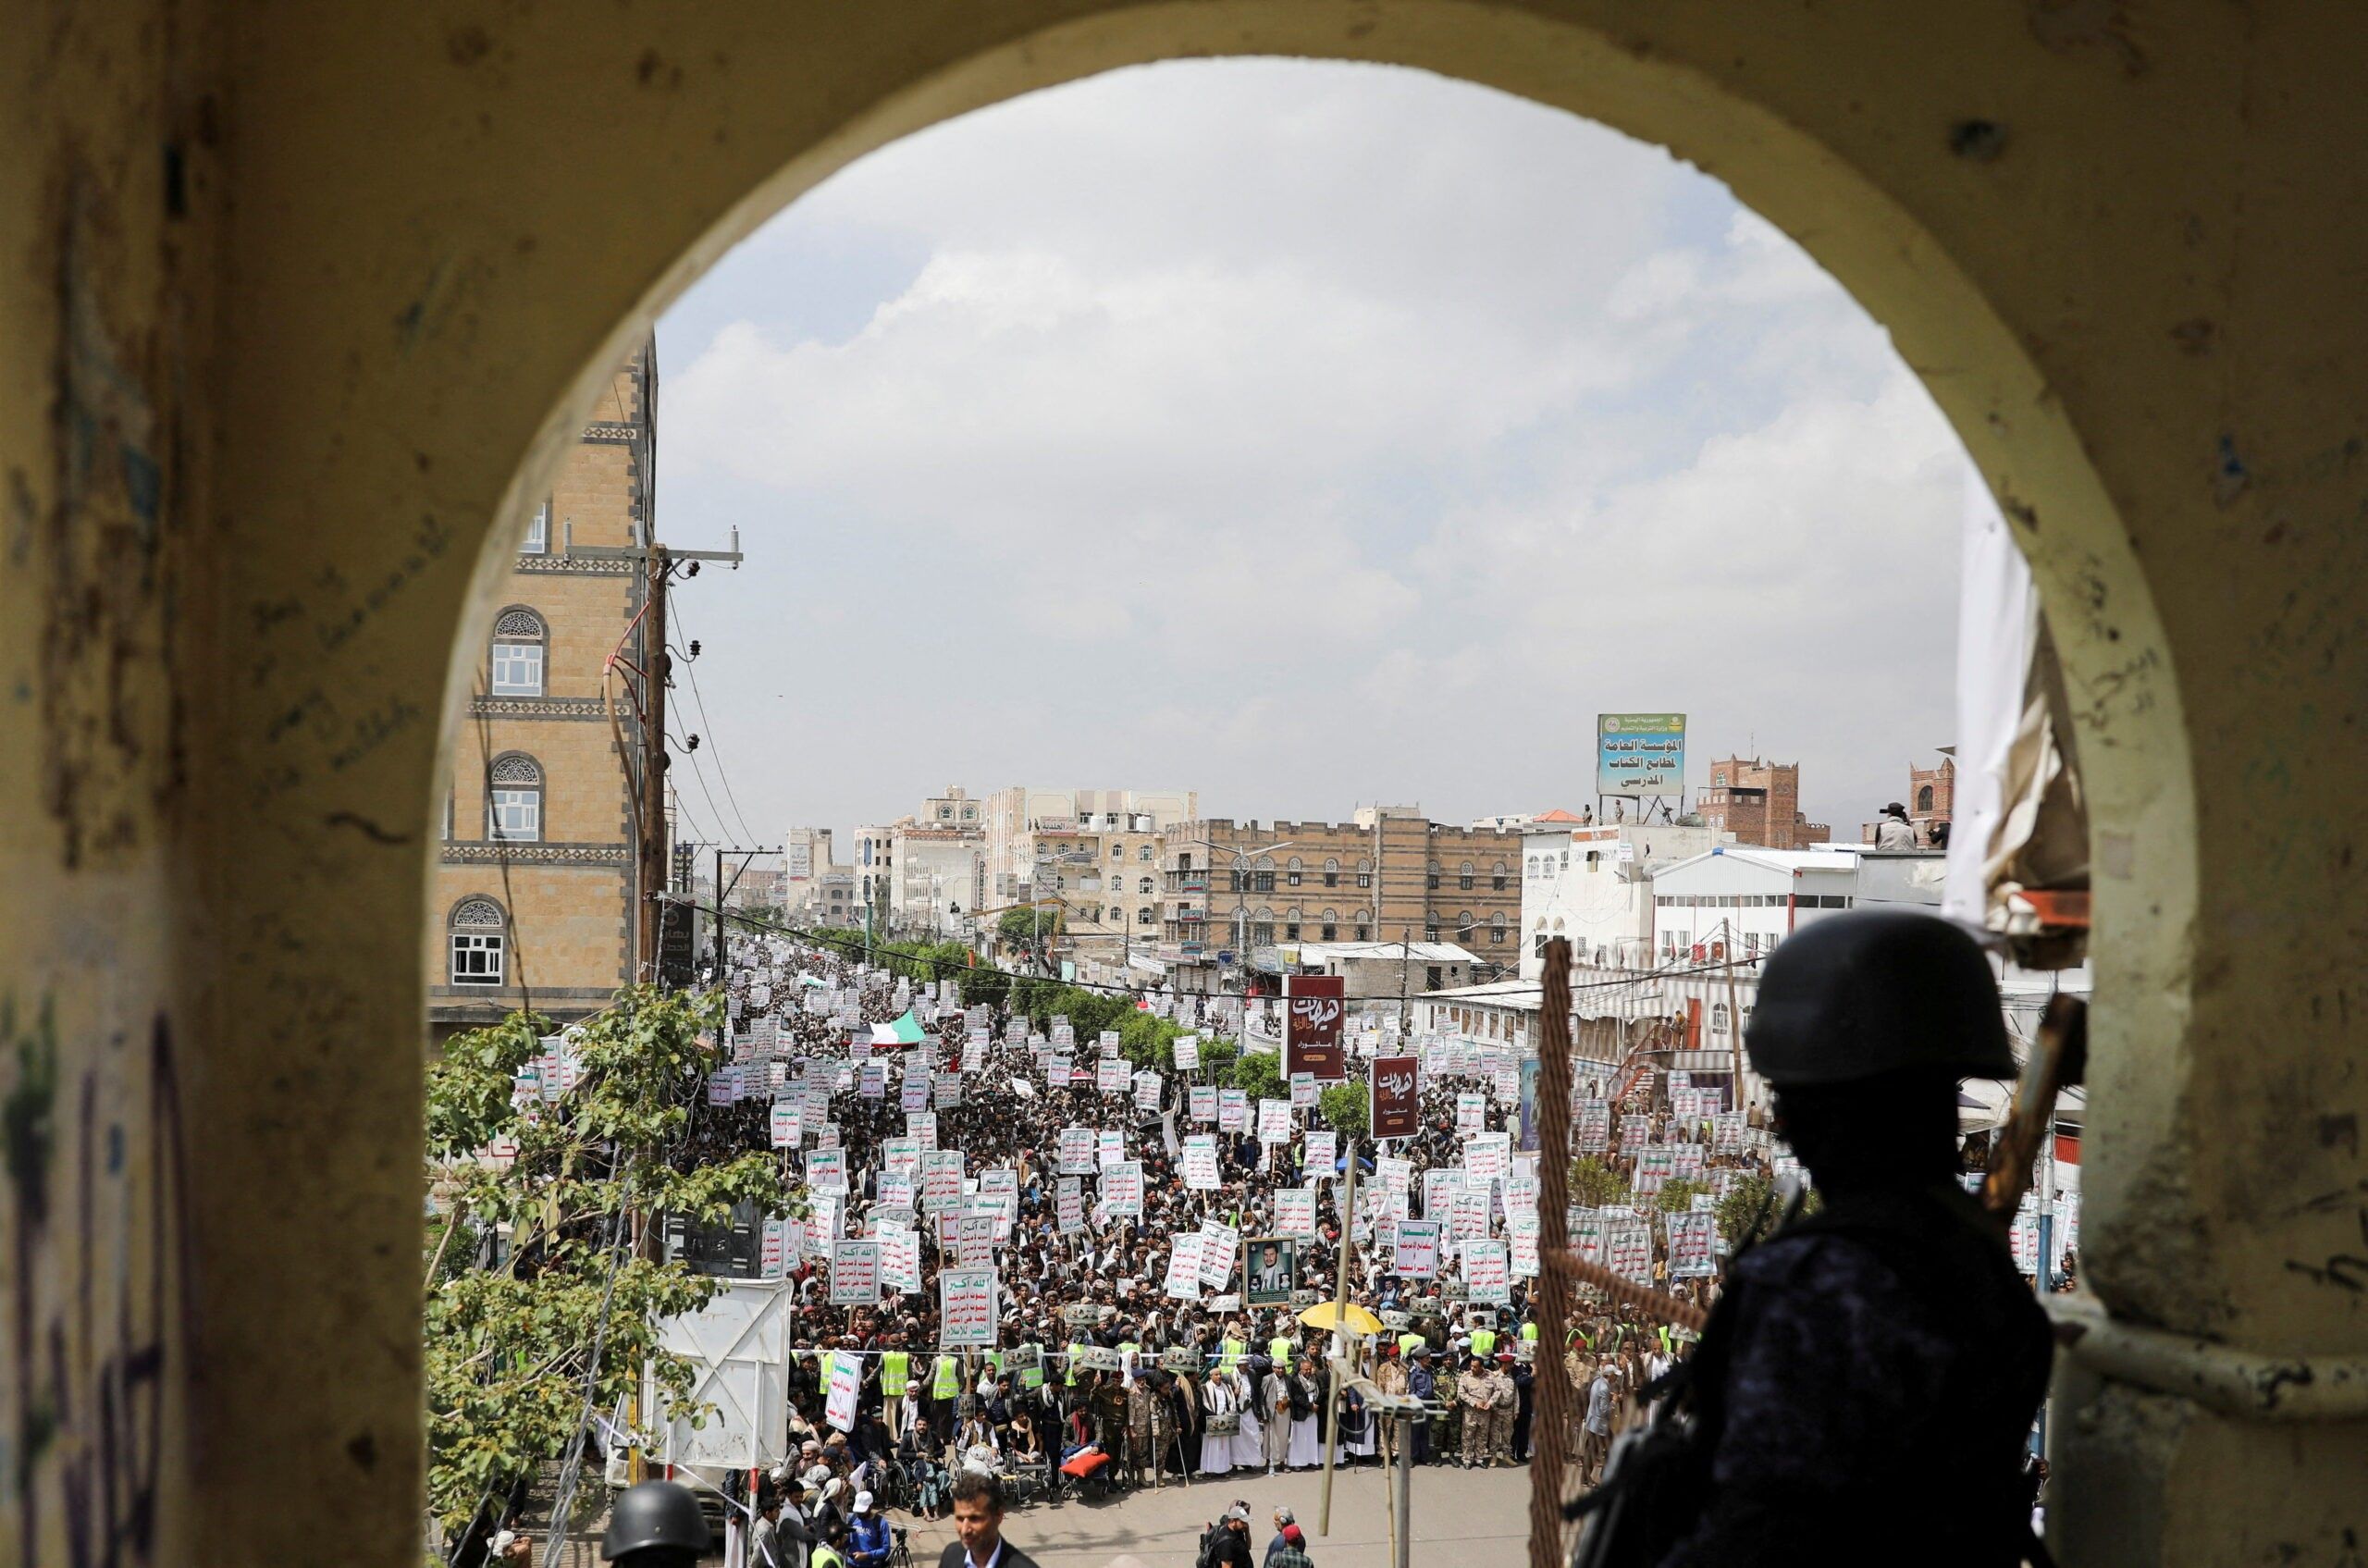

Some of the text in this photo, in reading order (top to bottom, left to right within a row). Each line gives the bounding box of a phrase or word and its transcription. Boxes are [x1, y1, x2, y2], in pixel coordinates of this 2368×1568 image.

[1605, 739, 1681, 753] المؤسسة العامة
[1609, 757, 1676, 771] لمطابع الكتاب
[1621, 774, 1663, 790] المدرسي
[1293, 995, 1339, 1031] هيهات
[1298, 1040, 1332, 1049] عاشوراء
[1378, 1071, 1413, 1100] هيهات
[838, 1246, 860, 1258] أكبر
[948, 1276, 989, 1292] الله أكبر
[857, 1288, 872, 1298] النصر
[970, 1324, 989, 1338] النصر
